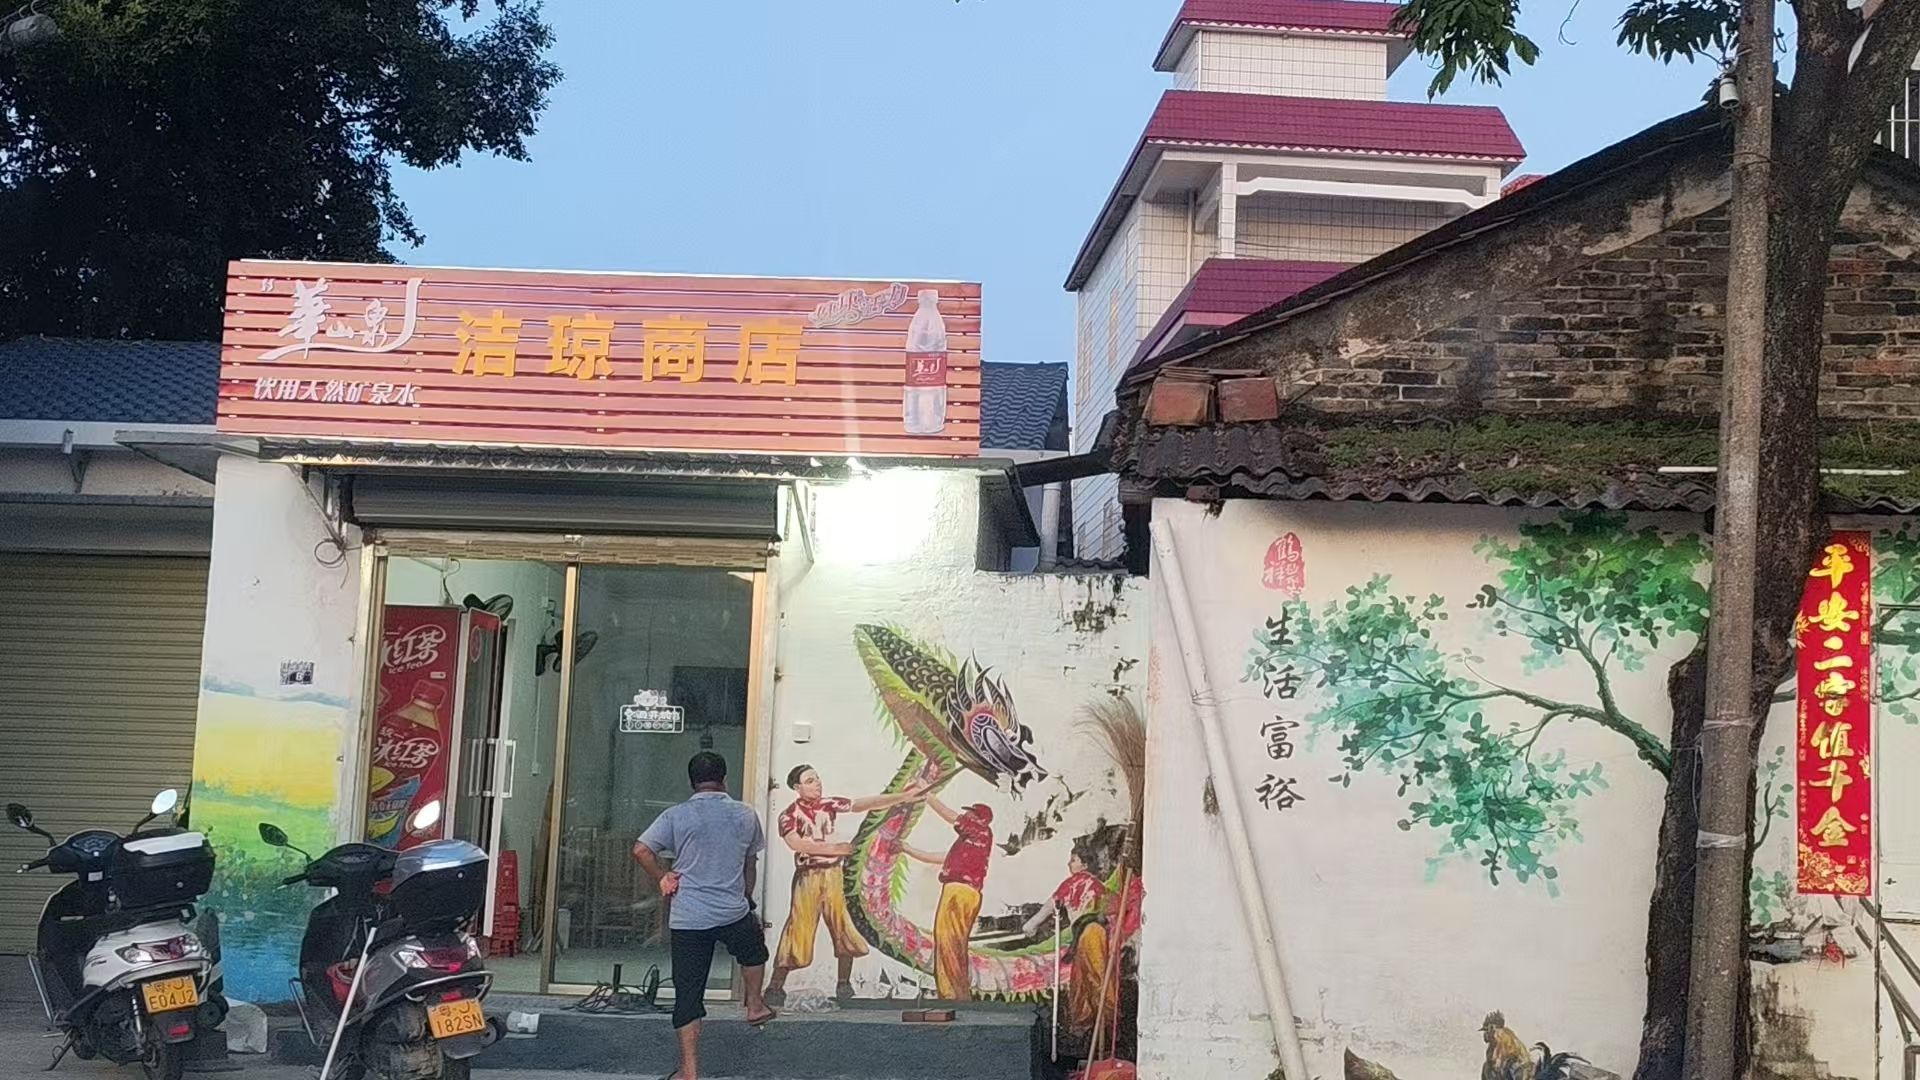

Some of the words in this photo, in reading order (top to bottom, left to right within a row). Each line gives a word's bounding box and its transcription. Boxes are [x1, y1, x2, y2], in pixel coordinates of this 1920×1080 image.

[452, 309, 804, 387] 洁琼商店
[253, 376, 420, 407] 饮用天然矿泉水
[1254, 606, 1306, 812] 生活富裕
[1808, 543, 1860, 848] 平安二字值千金
[436, 1012, 483, 1036] 182SN
